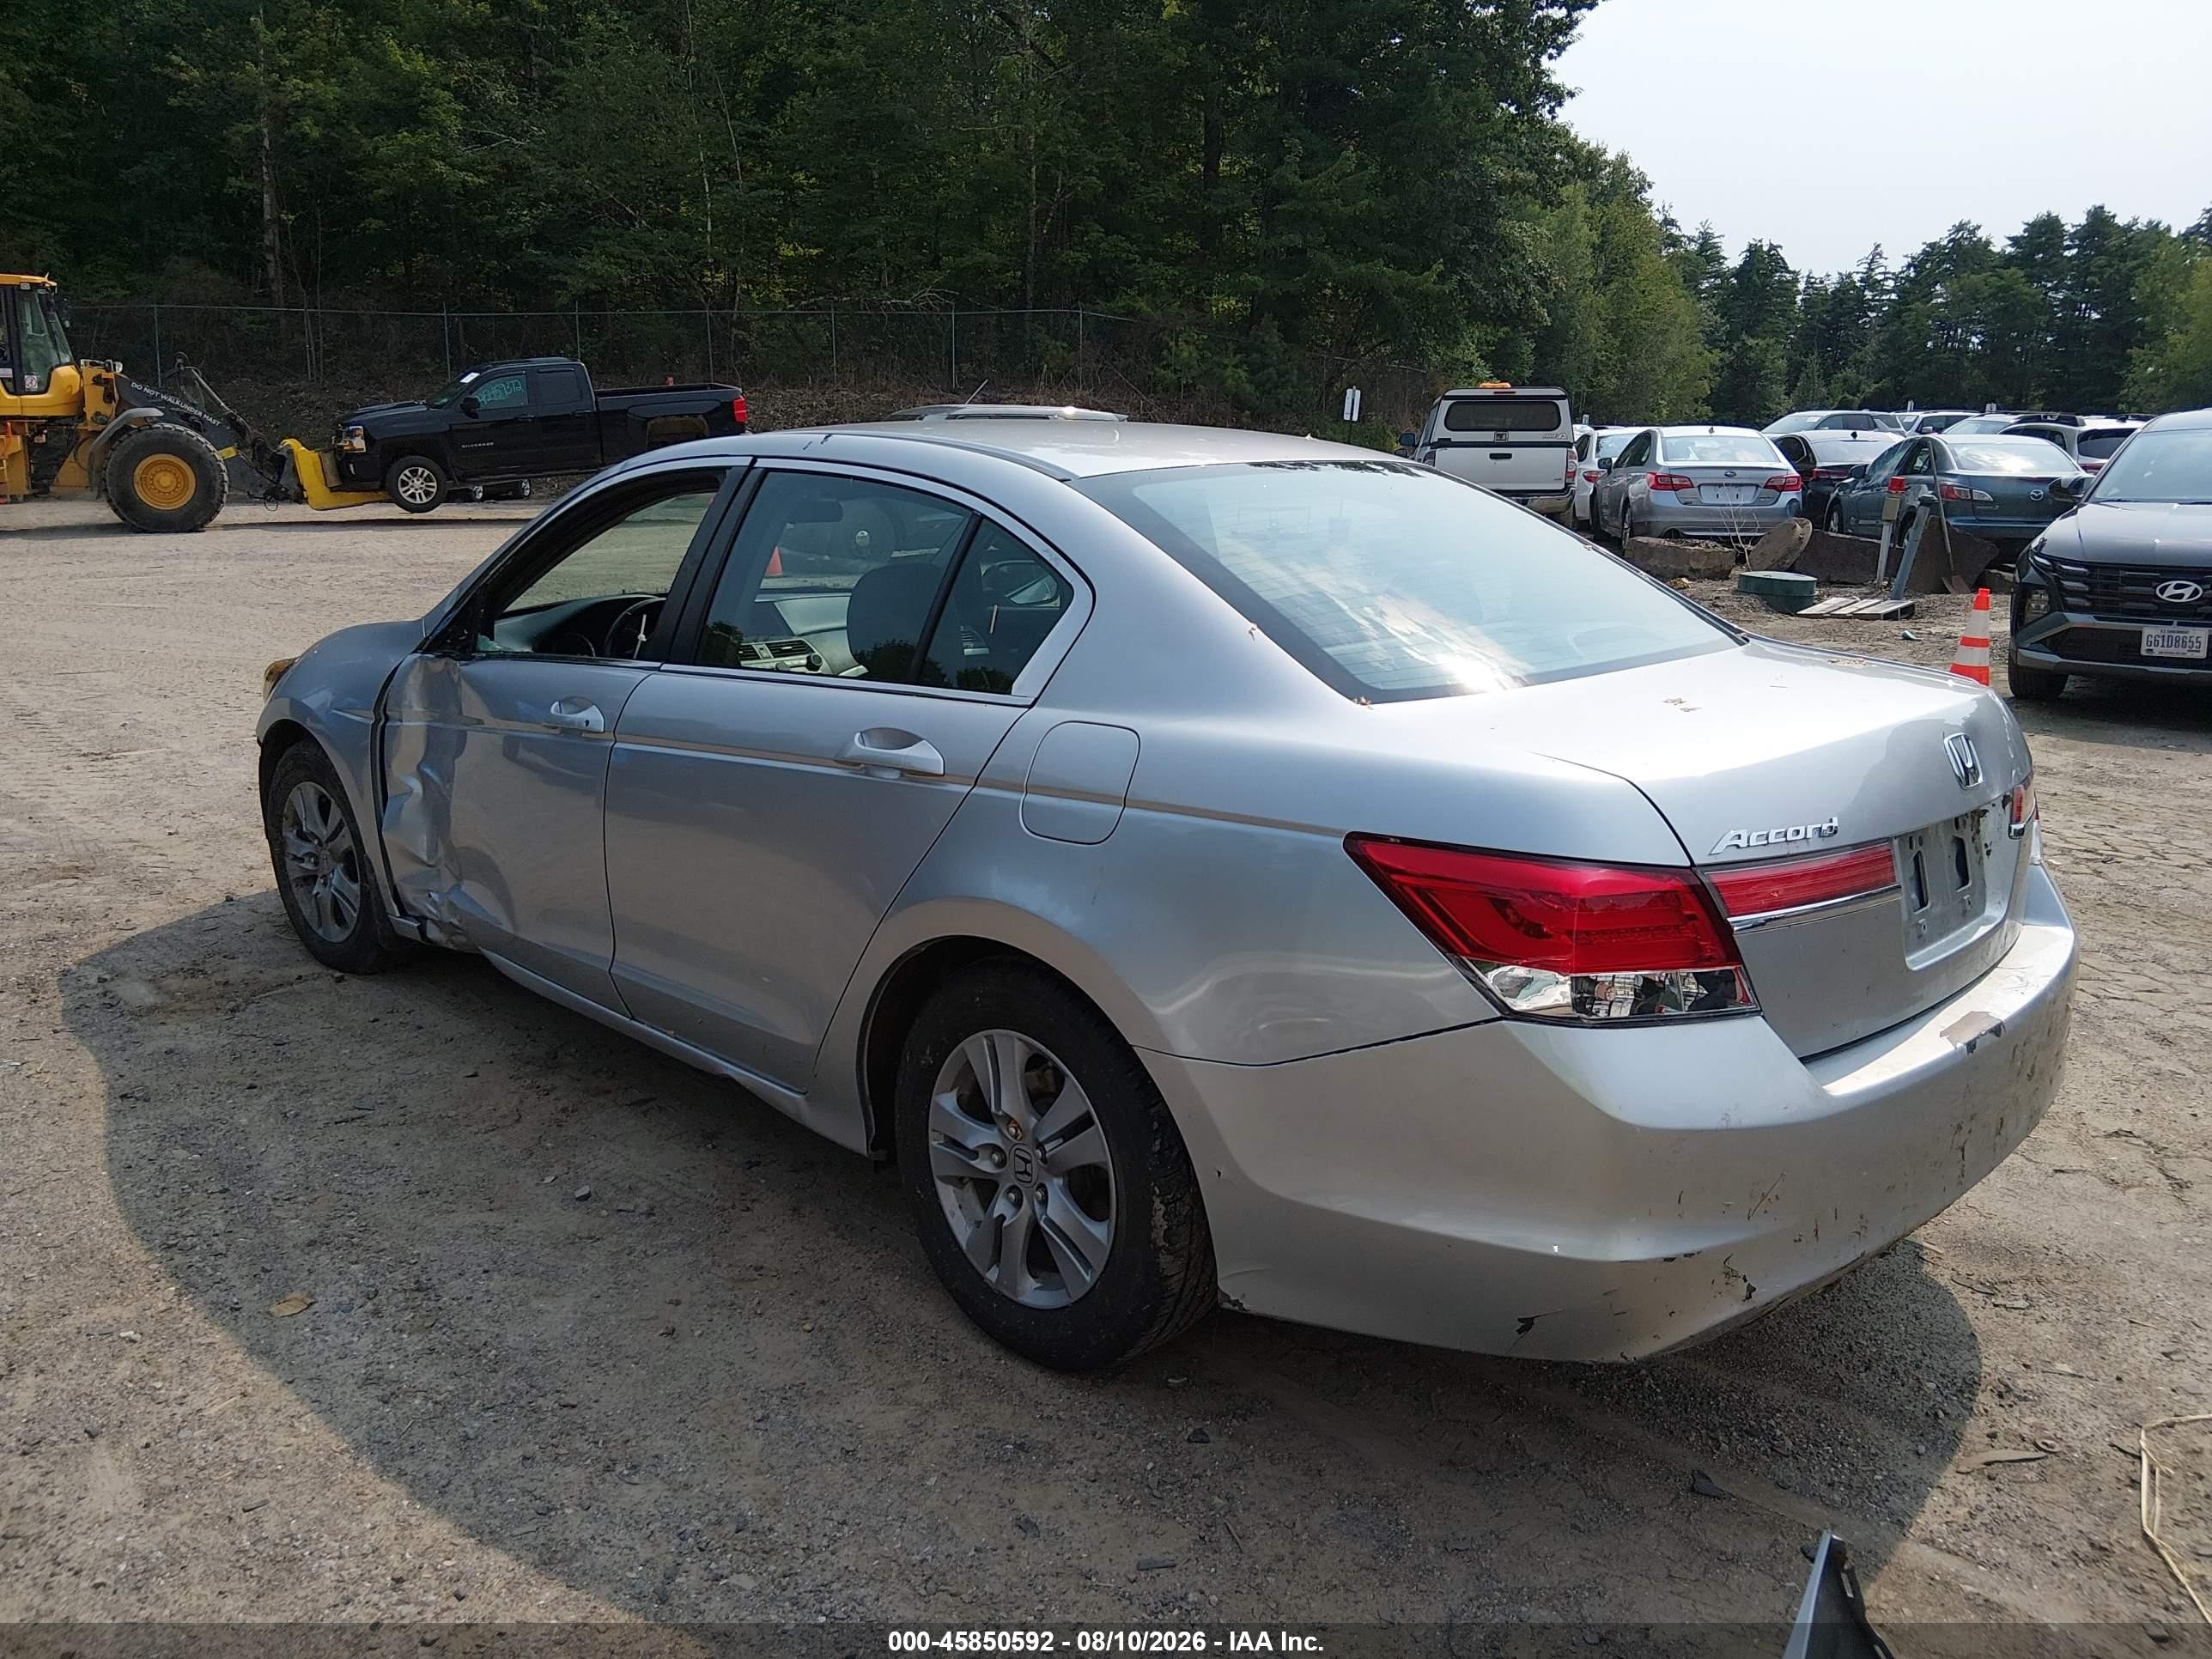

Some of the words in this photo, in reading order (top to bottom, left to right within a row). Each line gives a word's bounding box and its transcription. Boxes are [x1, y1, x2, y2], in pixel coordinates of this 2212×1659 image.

[131, 381, 143, 391] DO
[143, 387, 160, 398] NOT
[203, 414, 222, 427] MAST
[2146, 634, 2202, 649] G61D8655
[1709, 817, 1838, 855] Accord
